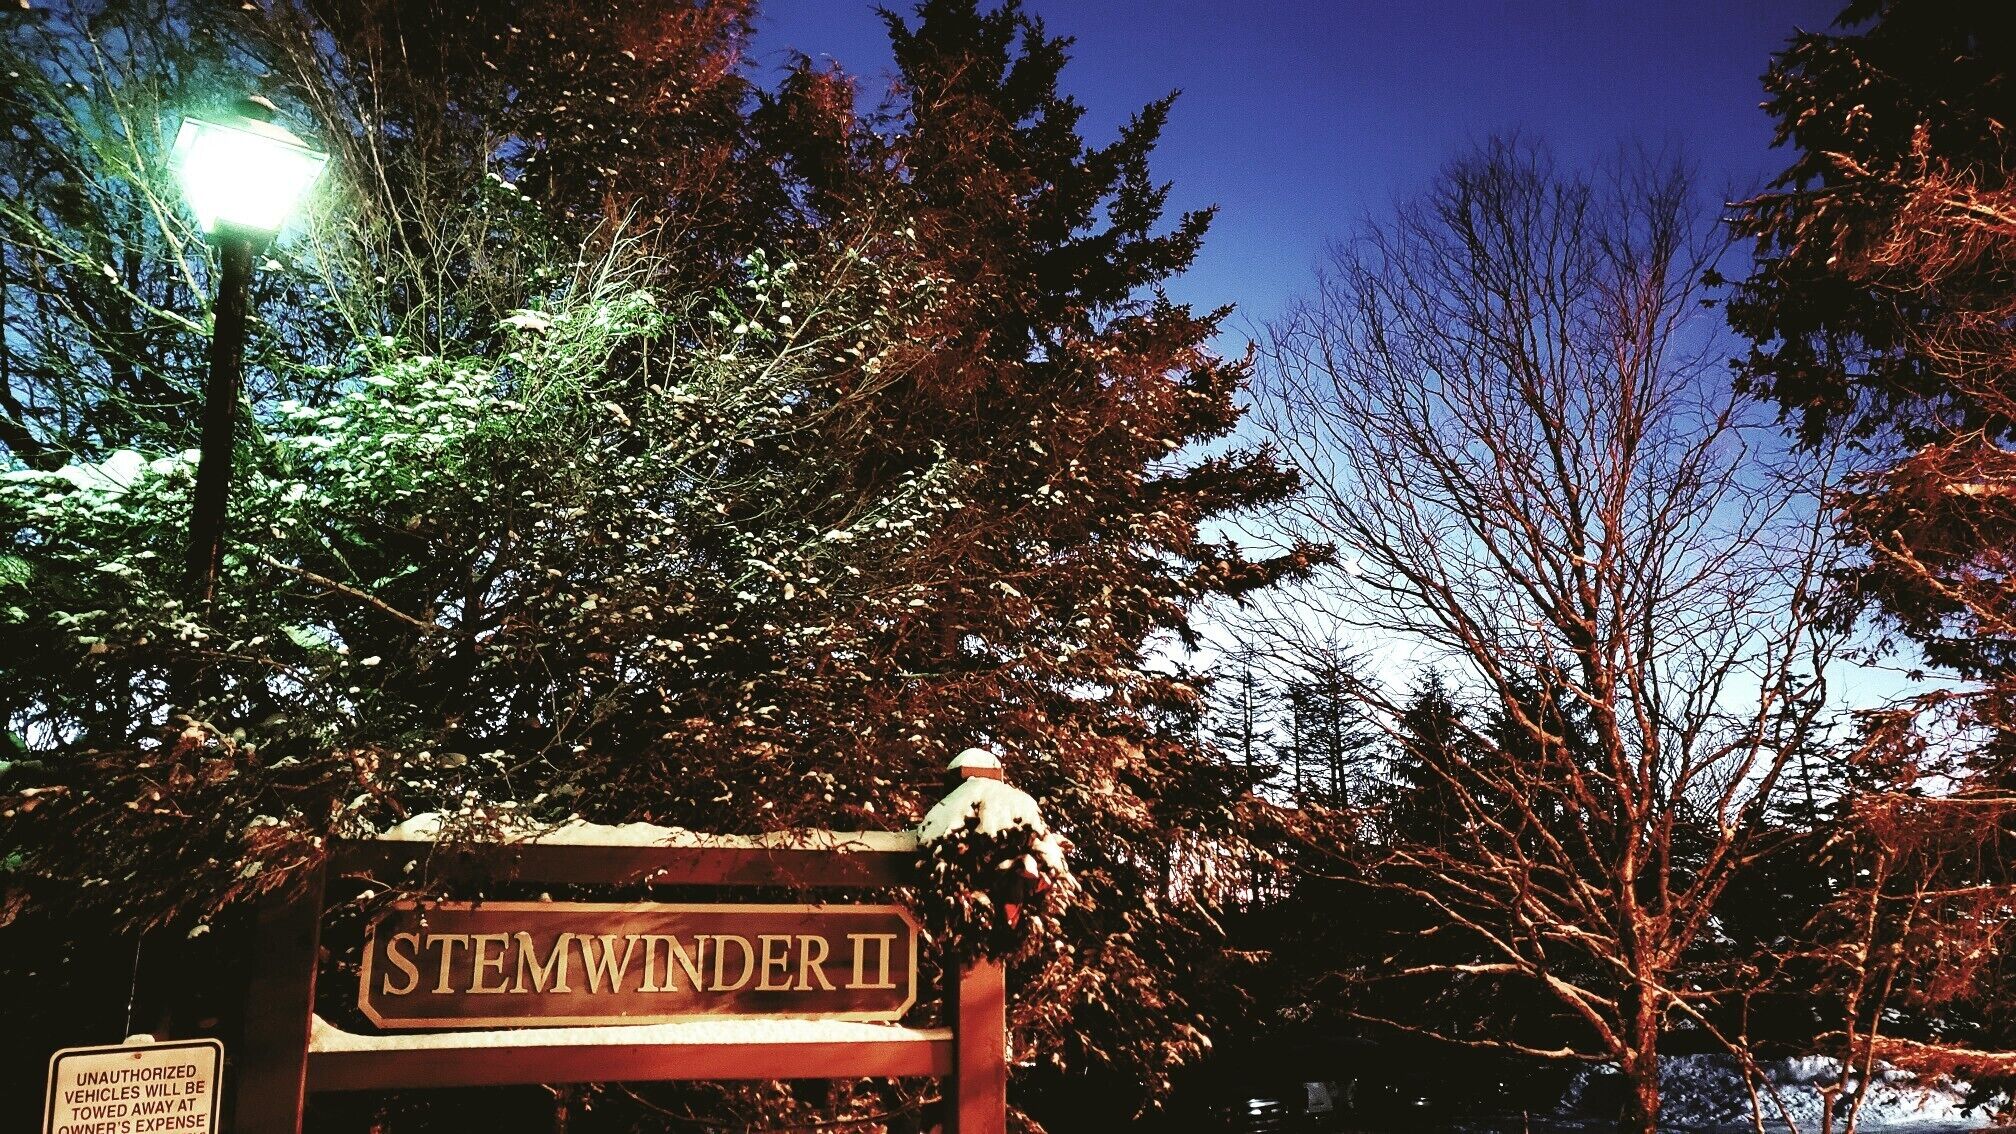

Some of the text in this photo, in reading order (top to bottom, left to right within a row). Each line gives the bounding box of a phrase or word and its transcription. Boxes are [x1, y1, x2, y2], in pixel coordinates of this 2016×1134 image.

[382, 930, 898, 995] STEMWINDER II
[76, 1064, 197, 1086] UNAUTHORIZED
[65, 1080, 205, 1104] VEHICLES WILL BE
[72, 1098, 197, 1121] TOWED AWAY AT
[58, 1114, 206, 1134] OWNER'S EXPENSE
